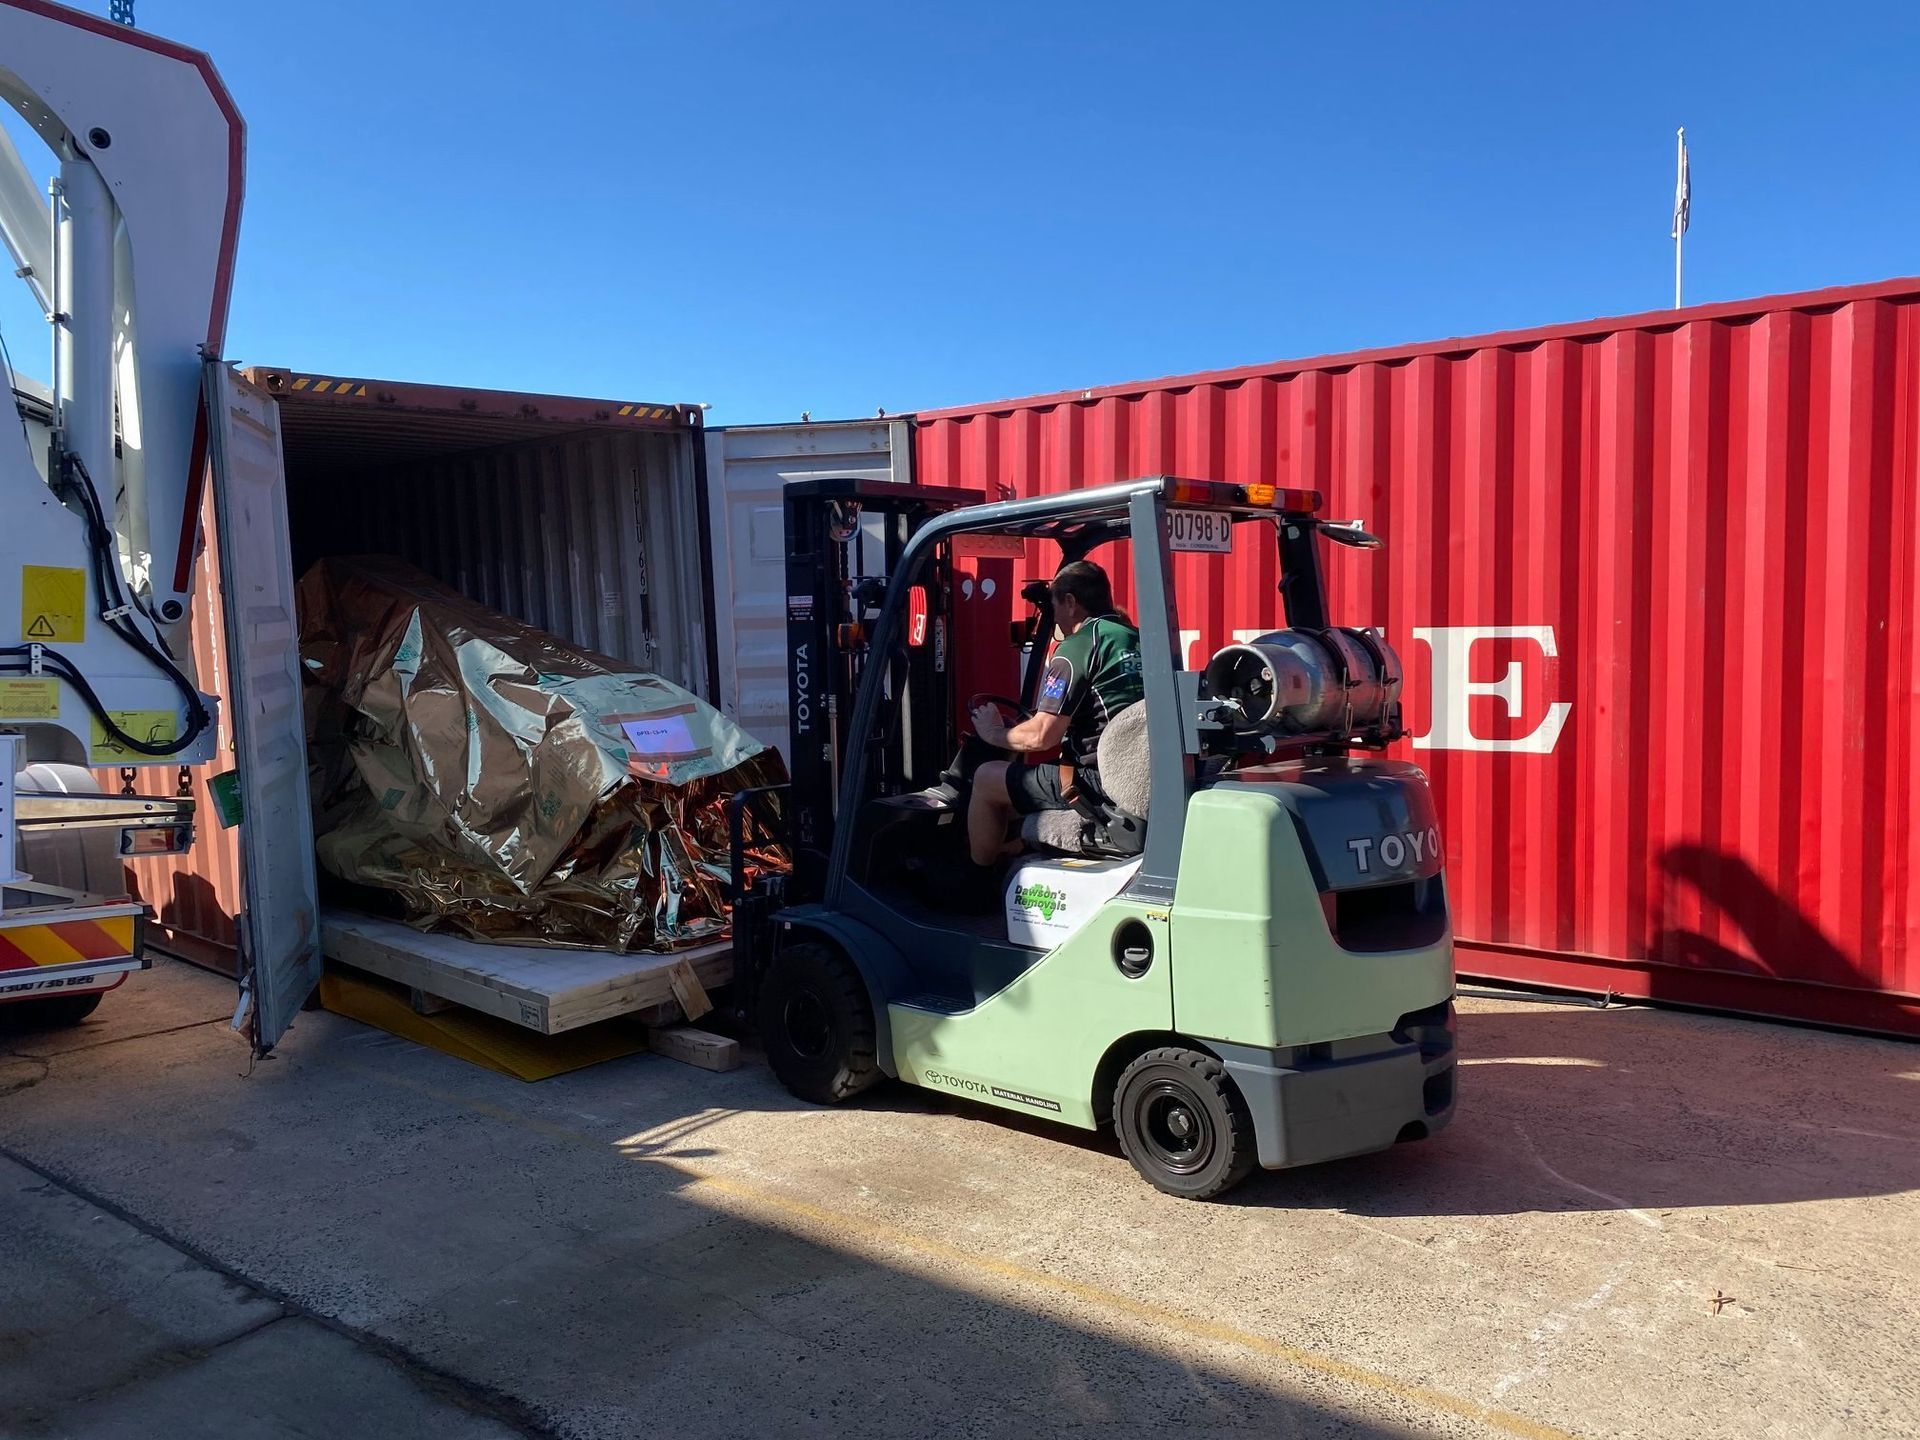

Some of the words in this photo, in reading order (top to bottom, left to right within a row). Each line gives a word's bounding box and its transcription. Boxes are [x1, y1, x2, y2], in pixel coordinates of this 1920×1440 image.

[797, 643, 810, 735] TOYOTA
[1347, 824, 1439, 872] TOYO
[1014, 884, 1067, 902] Dawson's
[1014, 895, 1067, 912] Removals
[942, 1074, 989, 1095] TOYOTA
[993, 1089, 1024, 1102] MATERIAL
[1026, 1097, 1059, 1110] HANDLING
